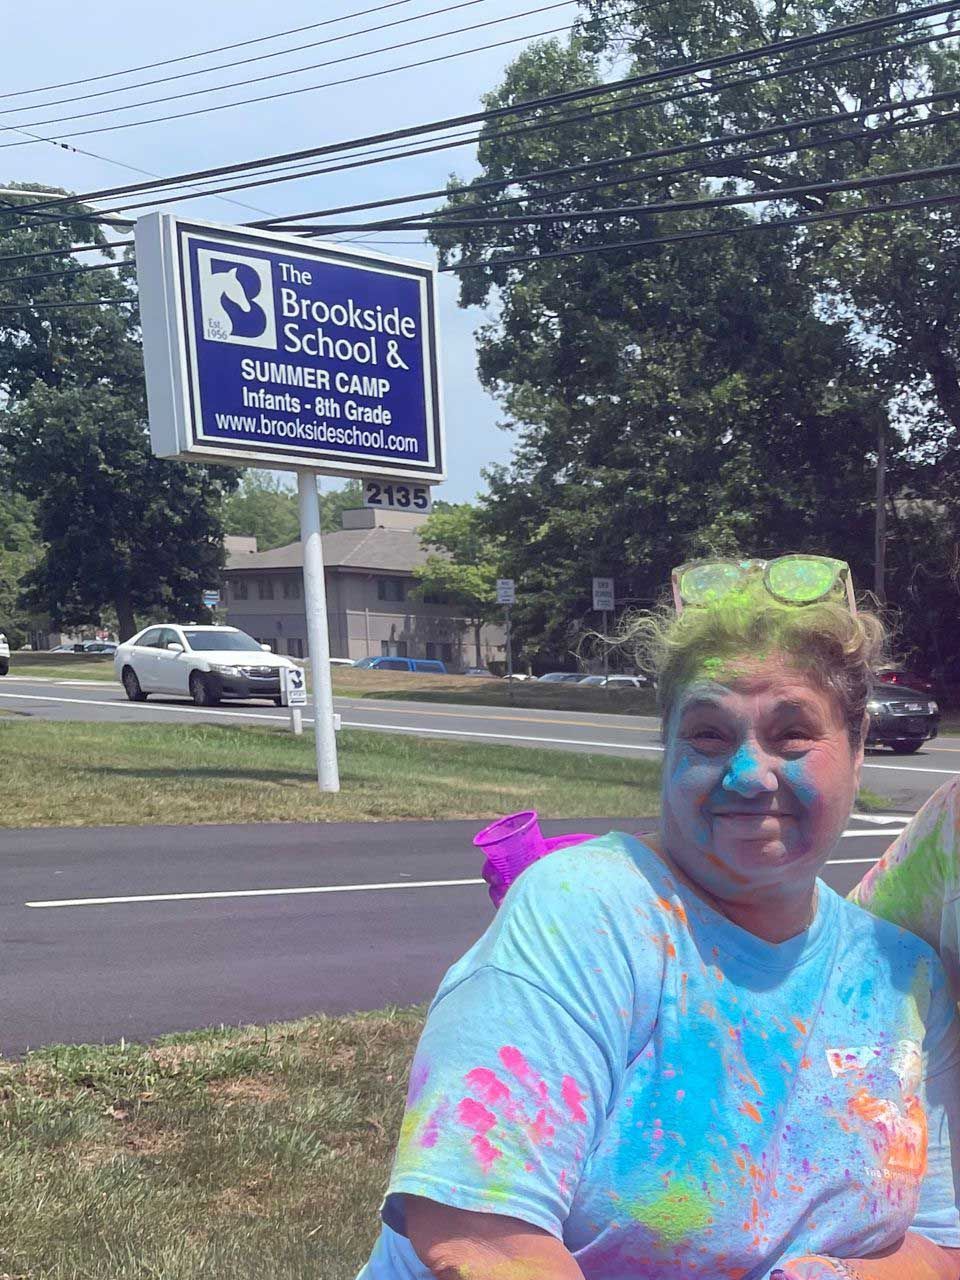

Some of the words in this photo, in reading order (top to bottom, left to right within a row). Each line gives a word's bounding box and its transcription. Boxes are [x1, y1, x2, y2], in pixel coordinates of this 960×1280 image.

[278, 262, 312, 286] The
[208, 317, 223, 330] Est.
[281, 287, 416, 339] Brookside
[207, 328, 228, 340] 1956
[283, 323, 378, 365] School
[386, 339, 410, 370] &
[241, 358, 330, 391] SUMMER
[335, 372, 391, 398] CAMP
[242, 386, 301, 413] Infants
[315, 396, 340, 419] 8th
[344, 399, 392, 426] Grade
[215, 413, 418, 453] www.brooksideschool.com
[366, 482, 429, 509] 2135
